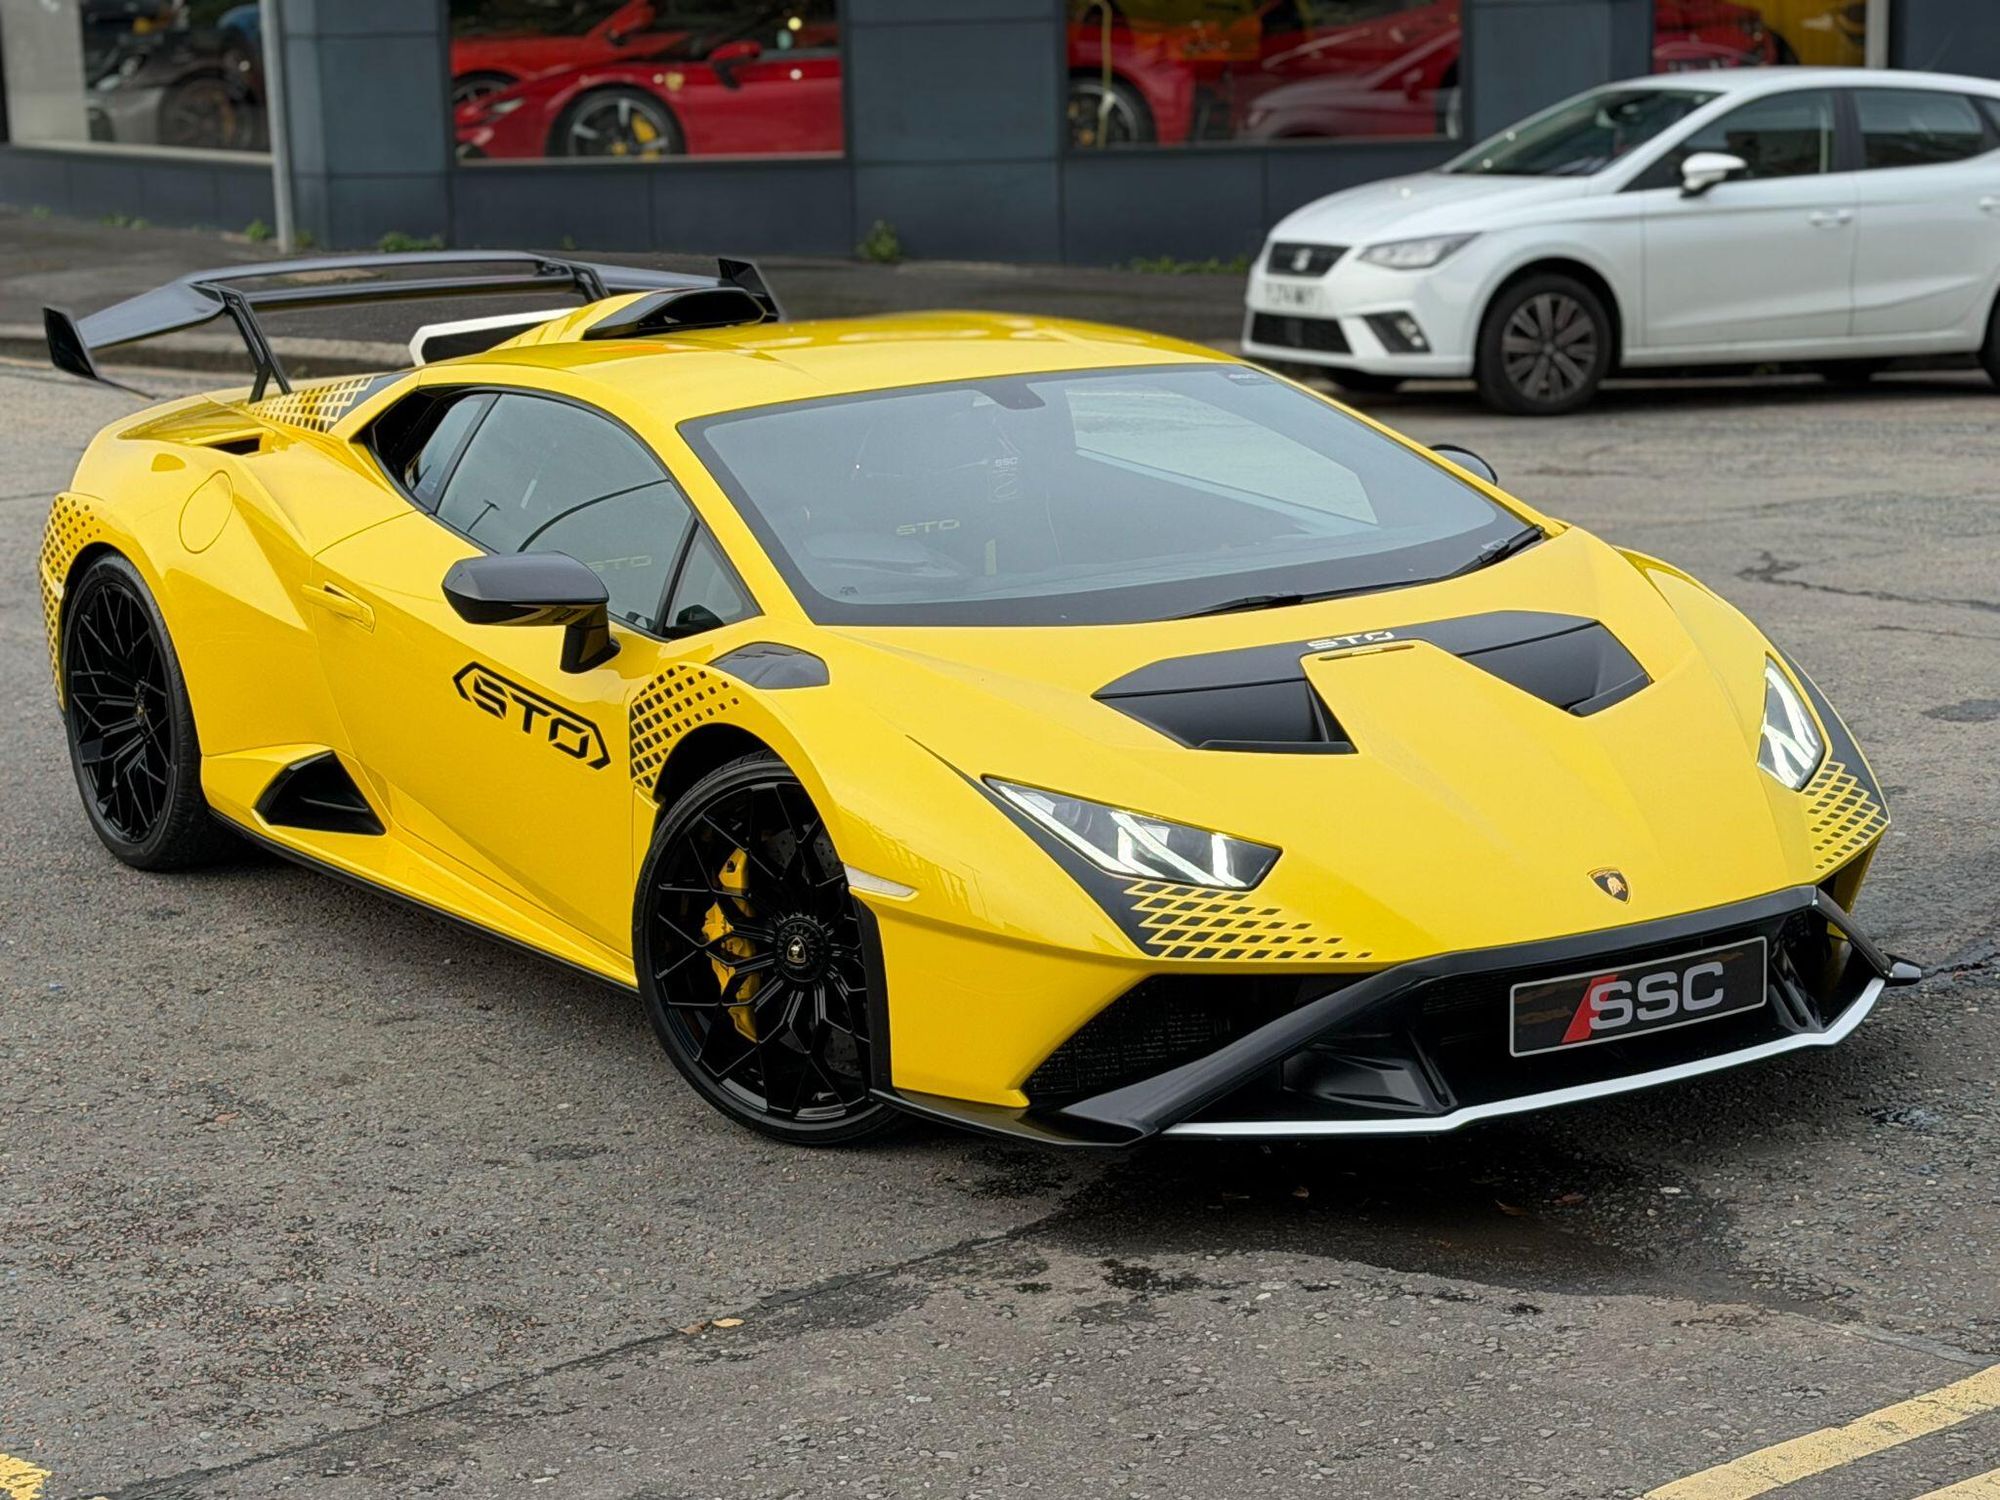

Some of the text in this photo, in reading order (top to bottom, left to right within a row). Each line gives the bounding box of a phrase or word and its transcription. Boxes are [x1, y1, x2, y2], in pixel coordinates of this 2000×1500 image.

[896, 519, 960, 535] STO
[1307, 631, 1394, 649] STO
[472, 674, 590, 759] STO
[1589, 961, 1724, 1031] SSC
